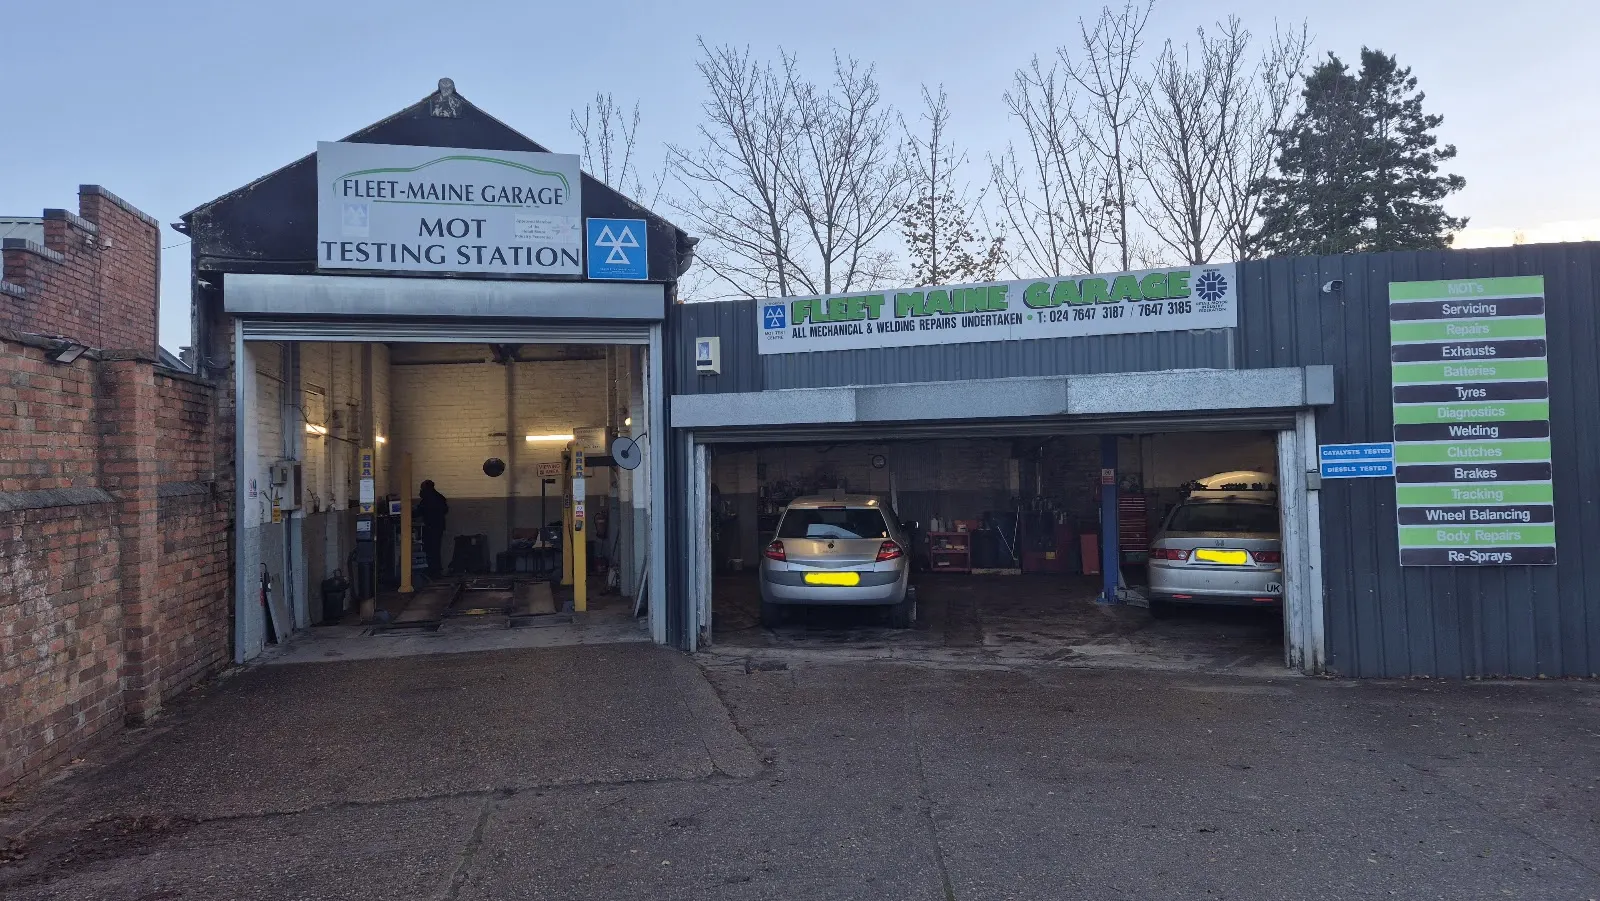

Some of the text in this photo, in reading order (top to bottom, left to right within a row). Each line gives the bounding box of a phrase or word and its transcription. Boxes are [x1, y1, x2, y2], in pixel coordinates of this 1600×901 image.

[343, 179, 563, 205] FLEET-MAINE GARAGE
[418, 217, 487, 238] MOT
[320, 241, 580, 267] TESTING STATION
[1448, 283, 1484, 294] MOT's
[791, 271, 1191, 325] FLEET MAINE GARAGE
[1442, 303, 1497, 315] Servicing
[792, 326, 807, 339] ALL
[810, 322, 863, 338] MECHANICAL
[866, 322, 873, 333] &
[877, 319, 915, 333] WELDING
[919, 316, 957, 331] REPAIRS
[962, 312, 1023, 328] UNDERTAKEN
[1037, 311, 1046, 323] T:
[1050, 310, 1068, 323] 024
[1073, 308, 1096, 321] 7647
[1102, 306, 1125, 319] 3187
[1138, 303, 1163, 316] 7647
[1167, 301, 1192, 314] 3185
[1447, 323, 1490, 336] Repairs
[1442, 345, 1496, 357] Exhausts
[1444, 365, 1496, 377] Batteries
[1456, 387, 1486, 400] Tyres
[1437, 406, 1505, 419] Diagnostics
[1449, 425, 1499, 438] Welding
[1447, 446, 1502, 457] Clutches
[1454, 467, 1497, 479] Brakes
[1451, 488, 1504, 501] Tracking
[1426, 508, 1531, 522] Wheel Balancing
[1437, 529, 1521, 543] Body Repairs
[1448, 550, 1512, 563] Re-Sprays
[1266, 584, 1280, 593] UK
